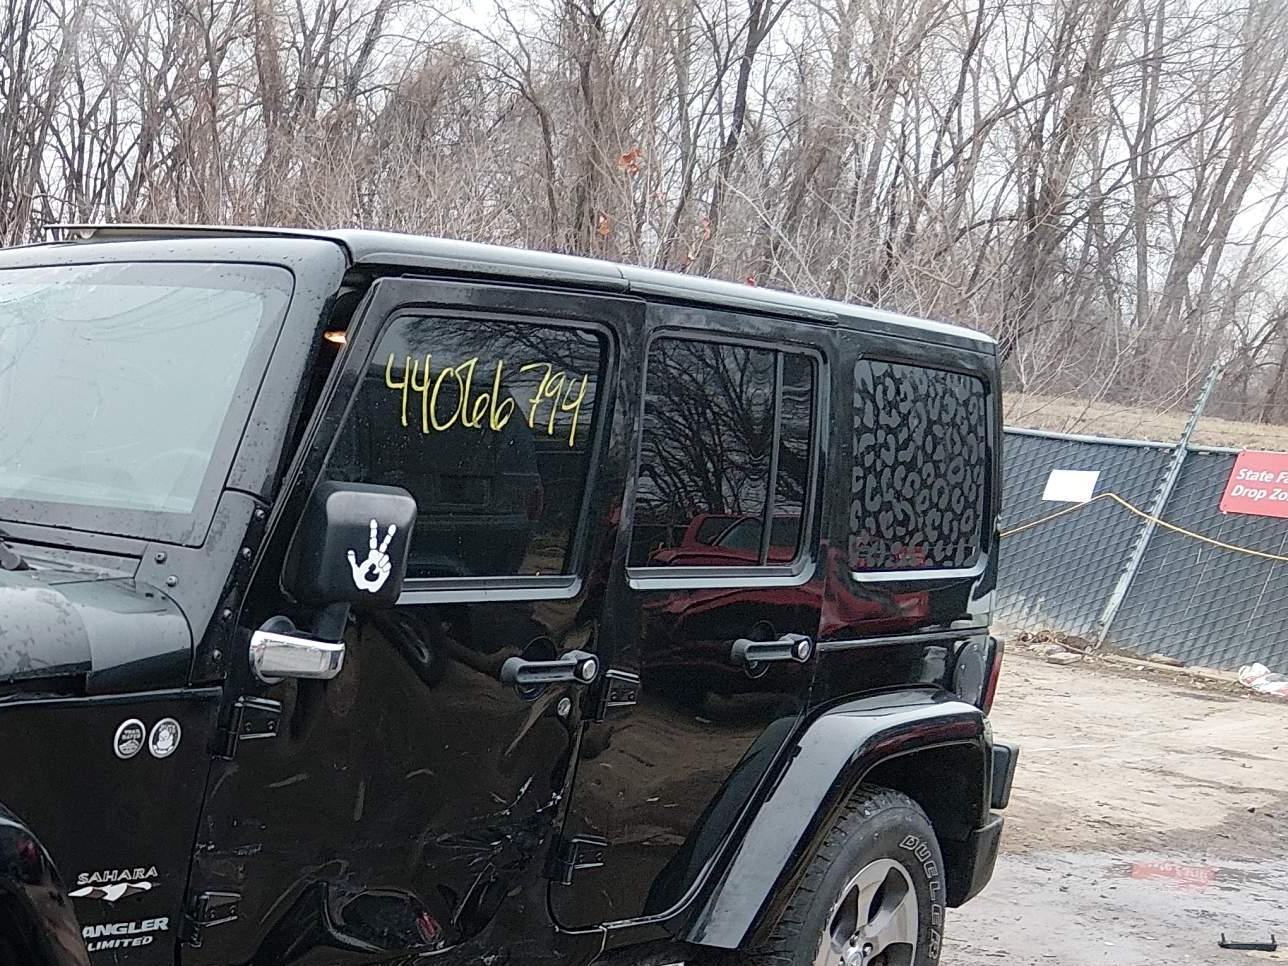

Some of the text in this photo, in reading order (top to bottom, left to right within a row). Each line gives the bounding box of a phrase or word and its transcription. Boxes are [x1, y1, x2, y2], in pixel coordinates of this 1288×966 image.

[385, 353, 589, 448] 44066794
[1236, 468, 1274, 482] State
[1231, 485, 1288, 502] Drop Zo
[77, 865, 158, 885] SAHARA
[899, 835, 942, 960] DUELER
